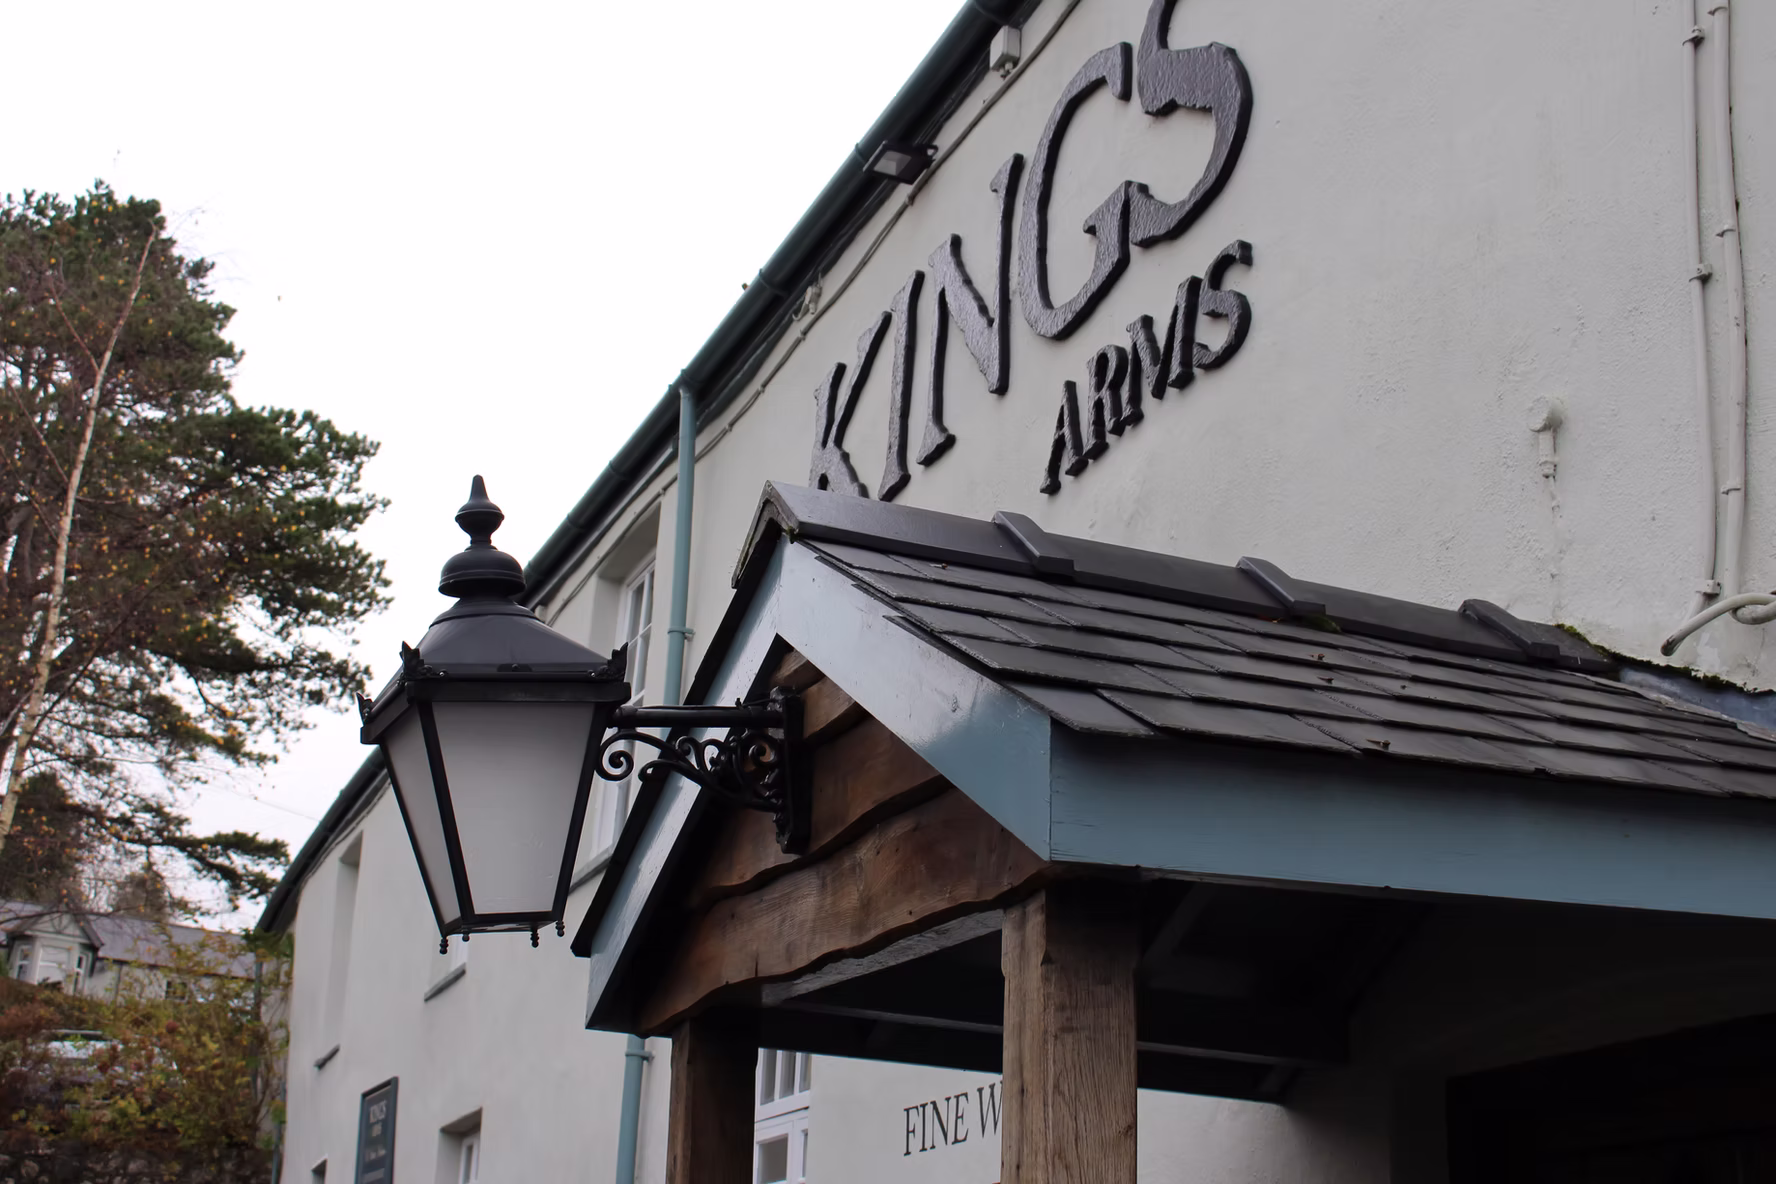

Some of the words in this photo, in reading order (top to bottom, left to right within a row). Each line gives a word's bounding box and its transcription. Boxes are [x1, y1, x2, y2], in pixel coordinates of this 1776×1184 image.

[808, 0, 1253, 501] KINGS
[1040, 240, 1252, 494] ARMS
[904, 1092, 969, 1157] FINE
